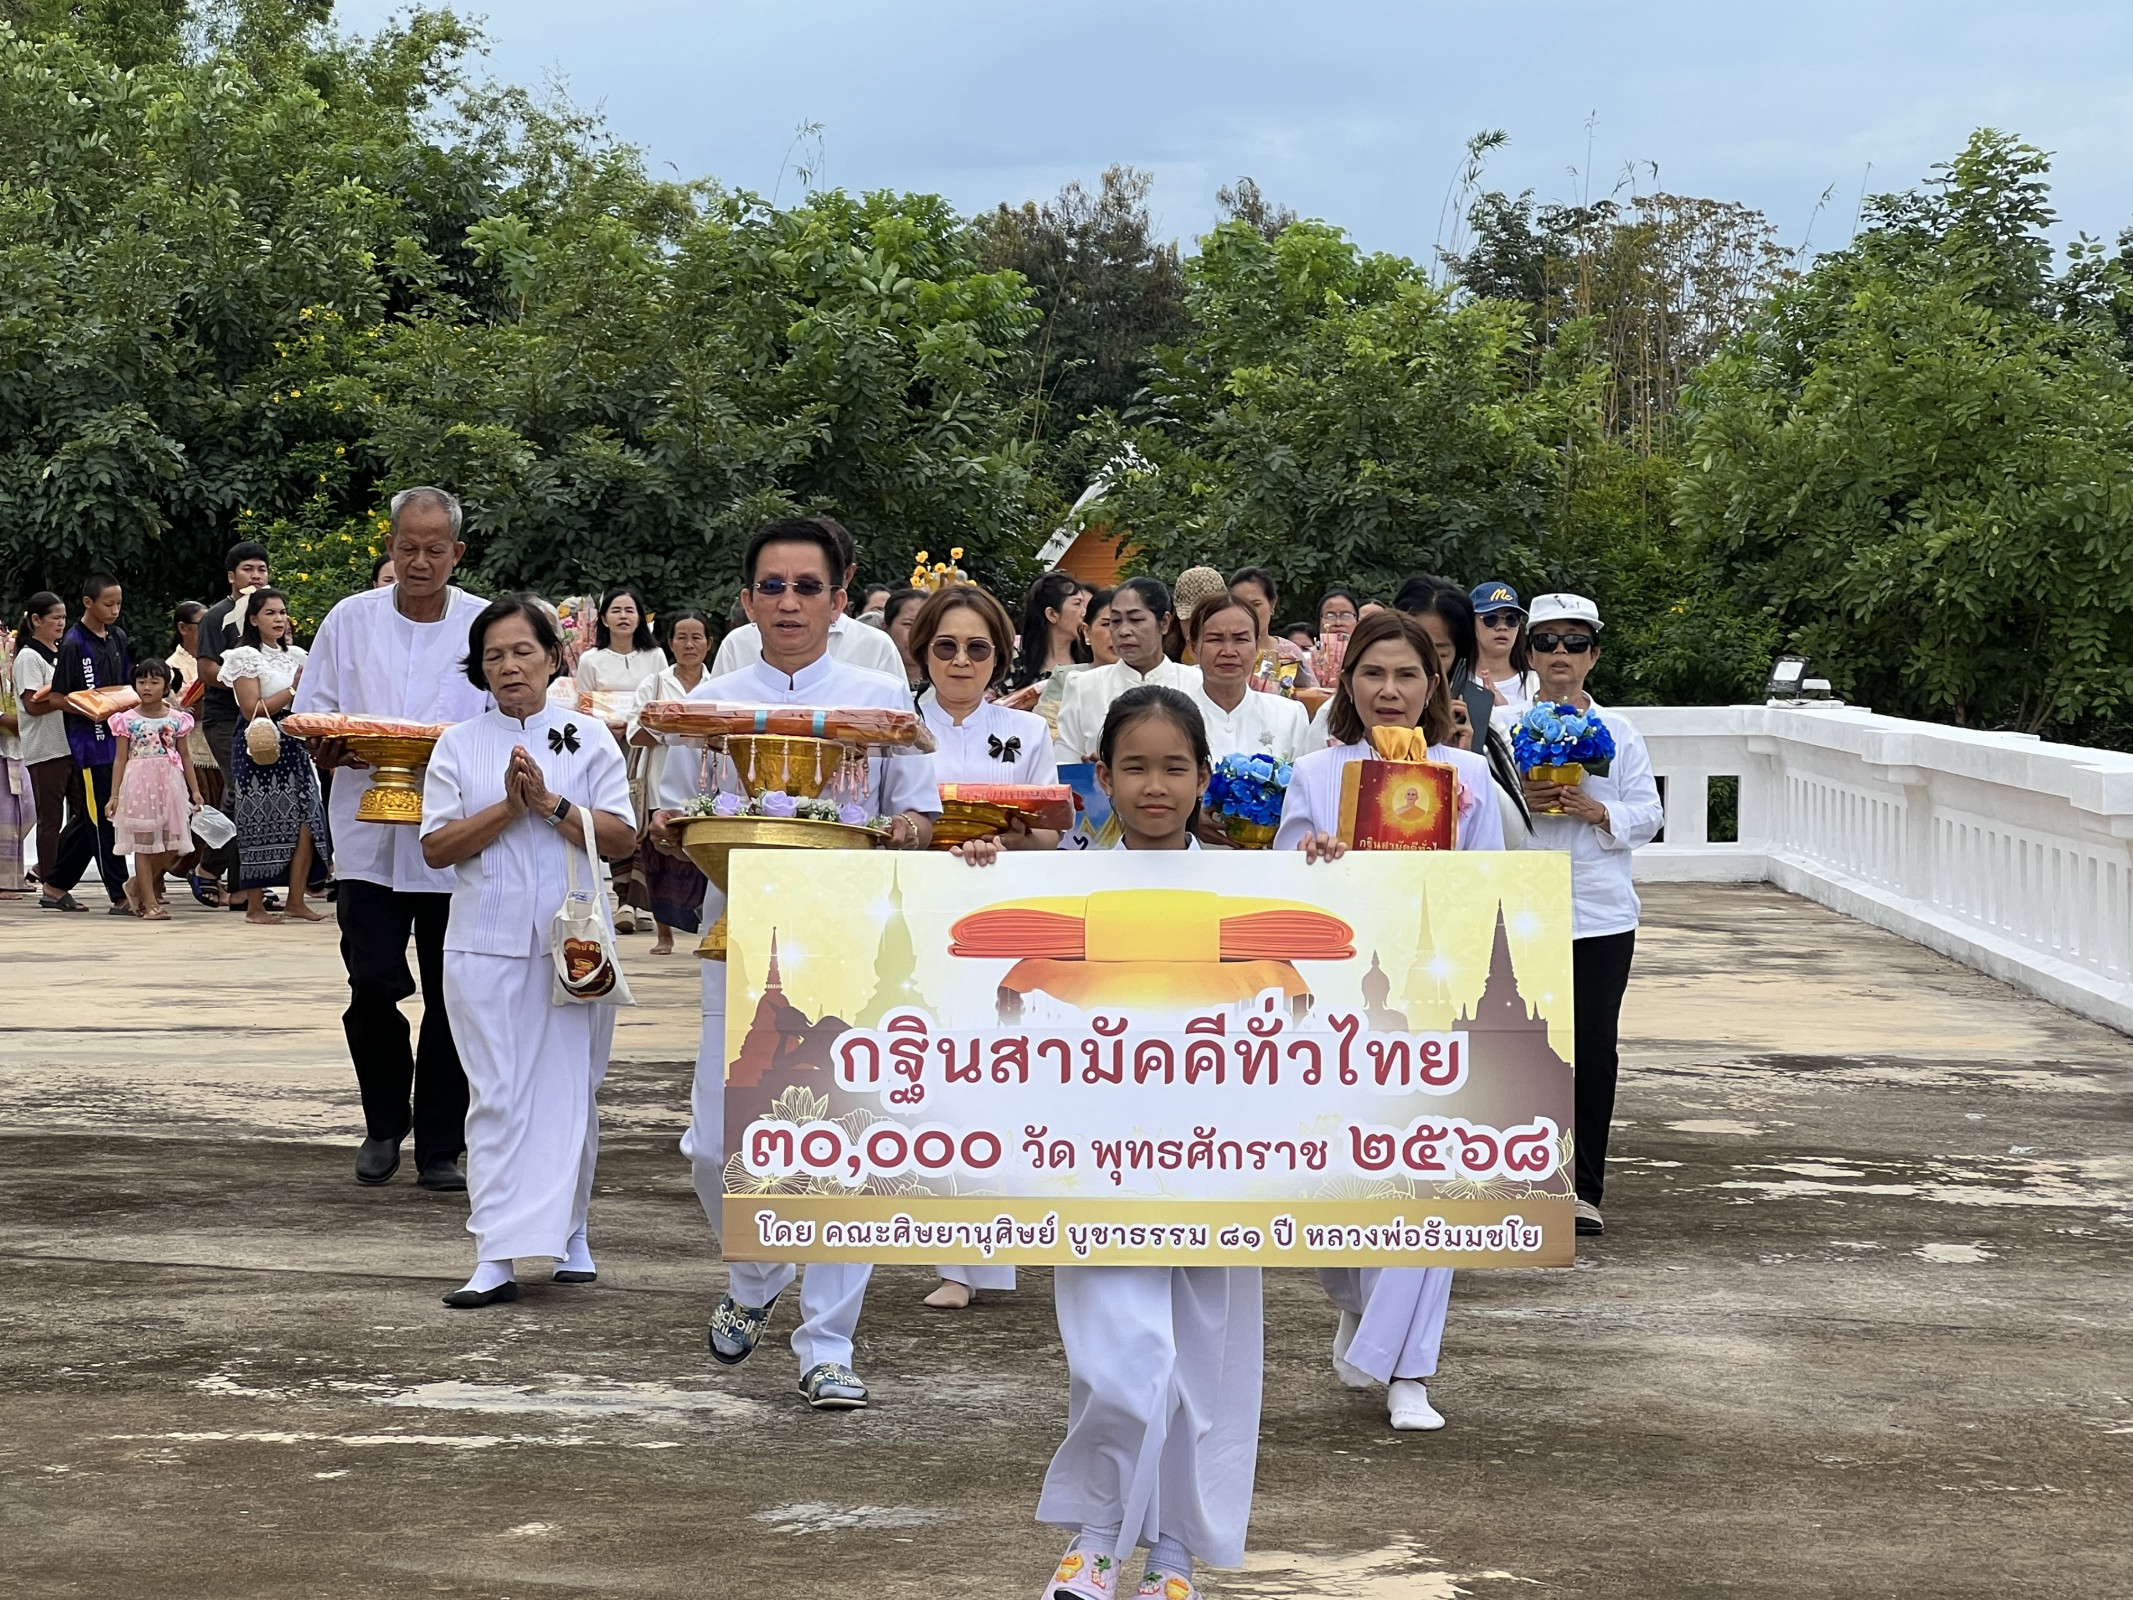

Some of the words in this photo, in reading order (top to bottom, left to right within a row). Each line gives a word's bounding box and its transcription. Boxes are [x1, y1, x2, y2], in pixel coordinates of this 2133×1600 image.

[840, 997, 1459, 1104] กฐินสามัคคีทั่วไทย
[751, 1129, 1002, 1178] ๓๐,๐๐๐
[1022, 1124, 1076, 1170] วัด
[1091, 1125, 1328, 1186] พุทธศักราช
[1348, 1124, 1551, 1172] ๒๕๖๘
[758, 1214, 812, 1243] โดย
[826, 1215, 1056, 1254] คณะศิษยานุศิษย์
[1068, 1226, 1206, 1255] บูชาธรรม
[1220, 1227, 1261, 1247] ๘๑
[1273, 1217, 1293, 1246] ปี
[1306, 1219, 1539, 1248] หลวงพ่อธัมมชโย
[715, 1303, 756, 1335] Scholl
